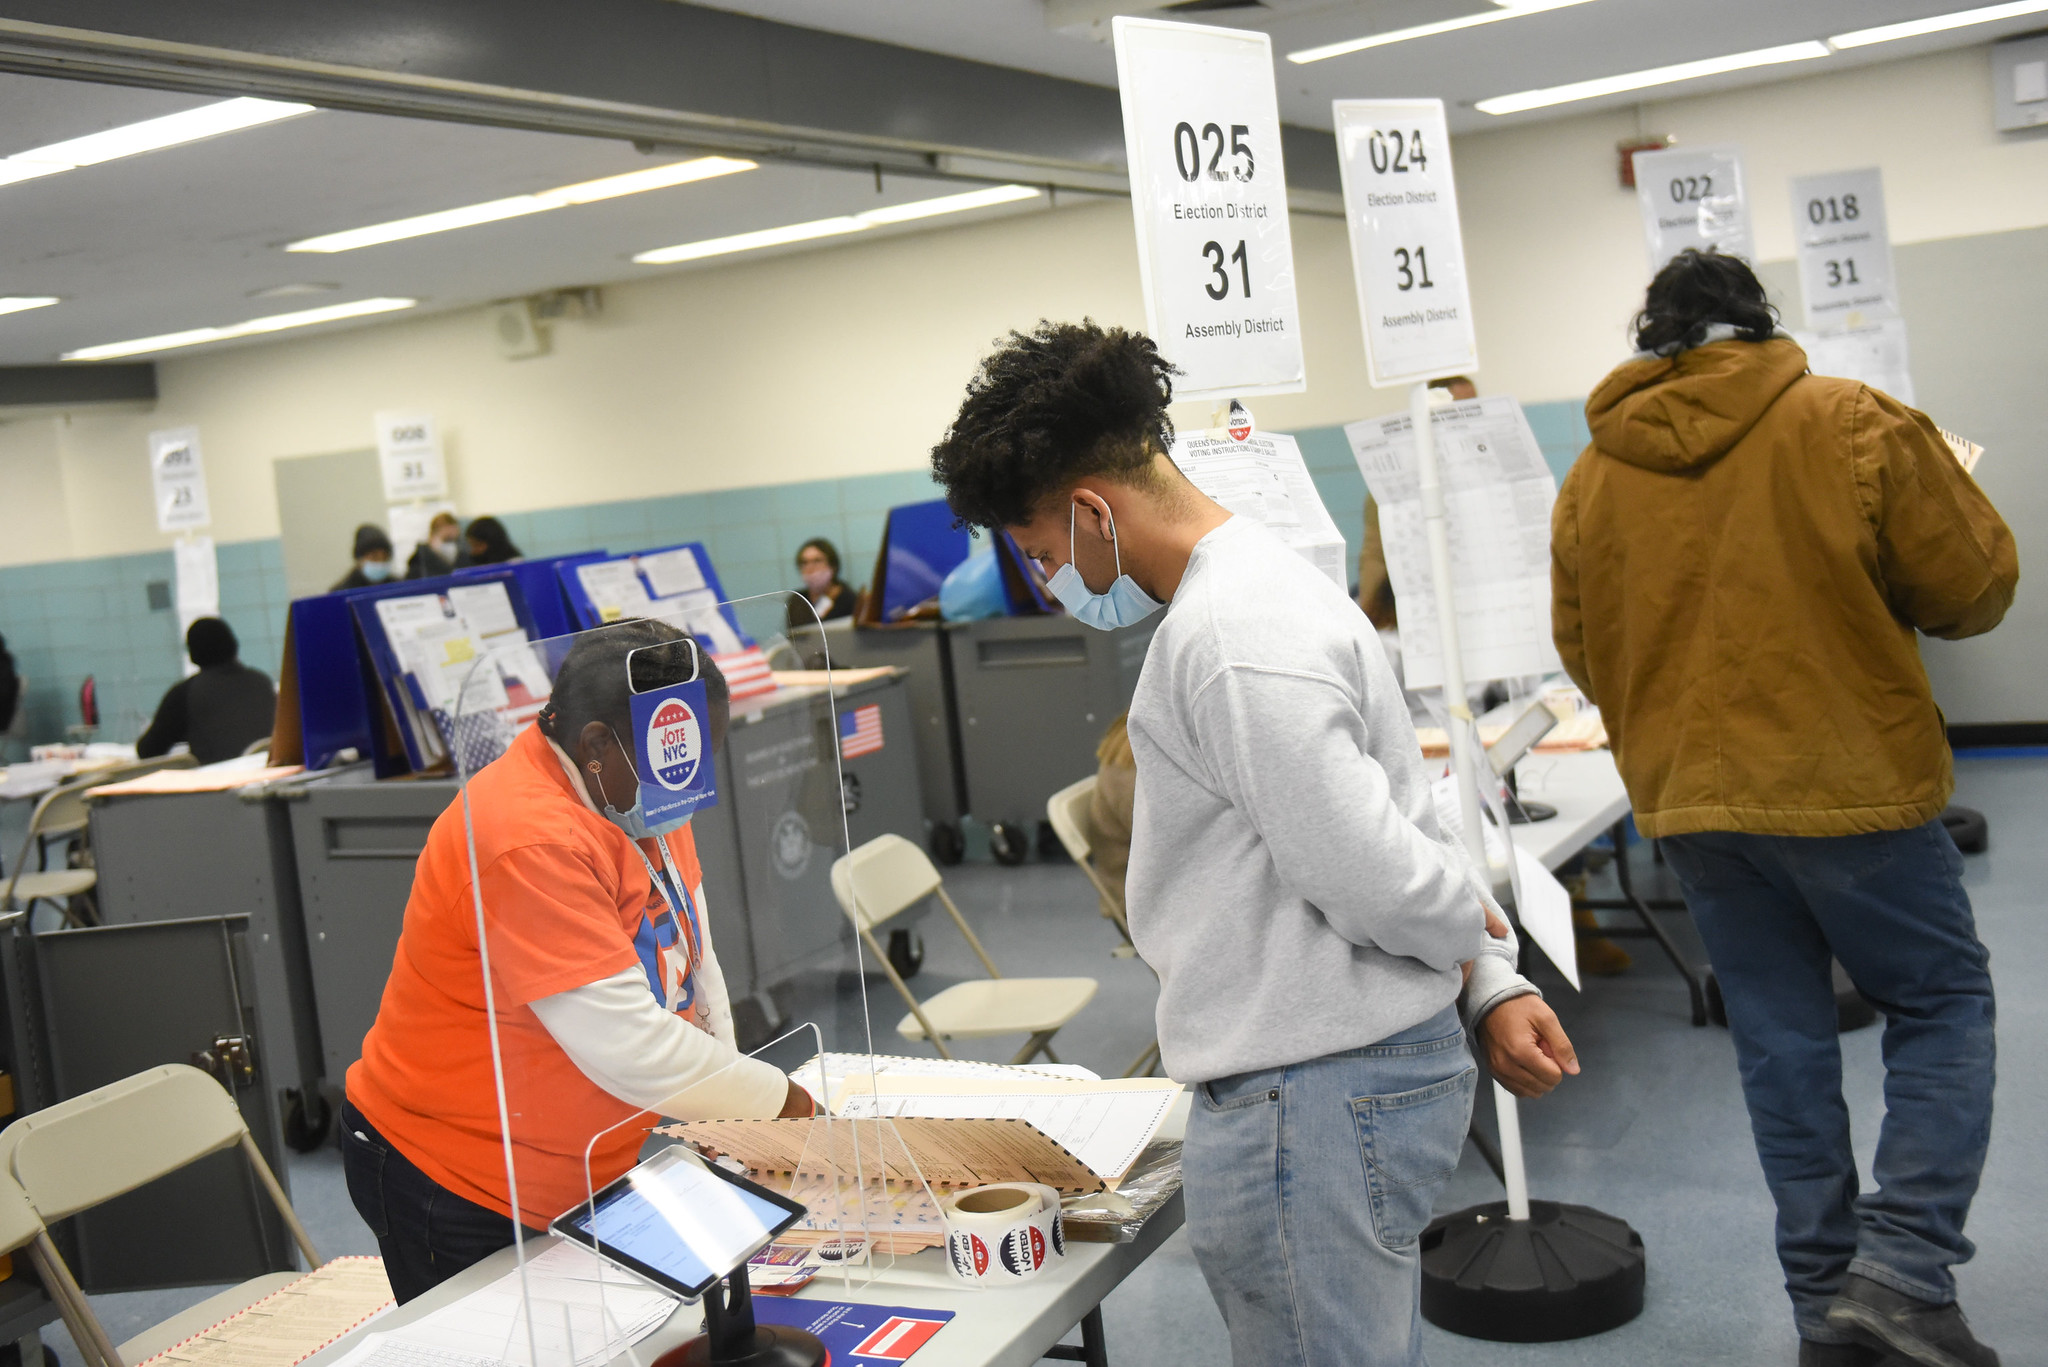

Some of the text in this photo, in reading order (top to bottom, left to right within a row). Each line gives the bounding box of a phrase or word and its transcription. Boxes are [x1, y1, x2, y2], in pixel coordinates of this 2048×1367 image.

[1174, 121, 1255, 183] 025
[1368, 129, 1427, 175] 024
[1367, 191, 1437, 207] Election District
[1670, 174, 1714, 203] 022
[1174, 203, 1268, 219] Election District
[1808, 193, 1860, 225] 018
[1202, 240, 1251, 301] 31
[1394, 246, 1434, 291] 31
[1825, 257, 1860, 288] 31
[1185, 317, 1284, 339] Assembly District
[1382, 307, 1457, 328] Assembly District
[1187, 439, 1210, 449] QUEENS
[1189, 448, 1211, 458] VOTING
[1211, 445, 1250, 456] INSTRUCTIONS
[661, 728, 686, 746] VOTE
[663, 743, 687, 762] NYC
[1019, 1230, 1031, 1266] VOTED!
